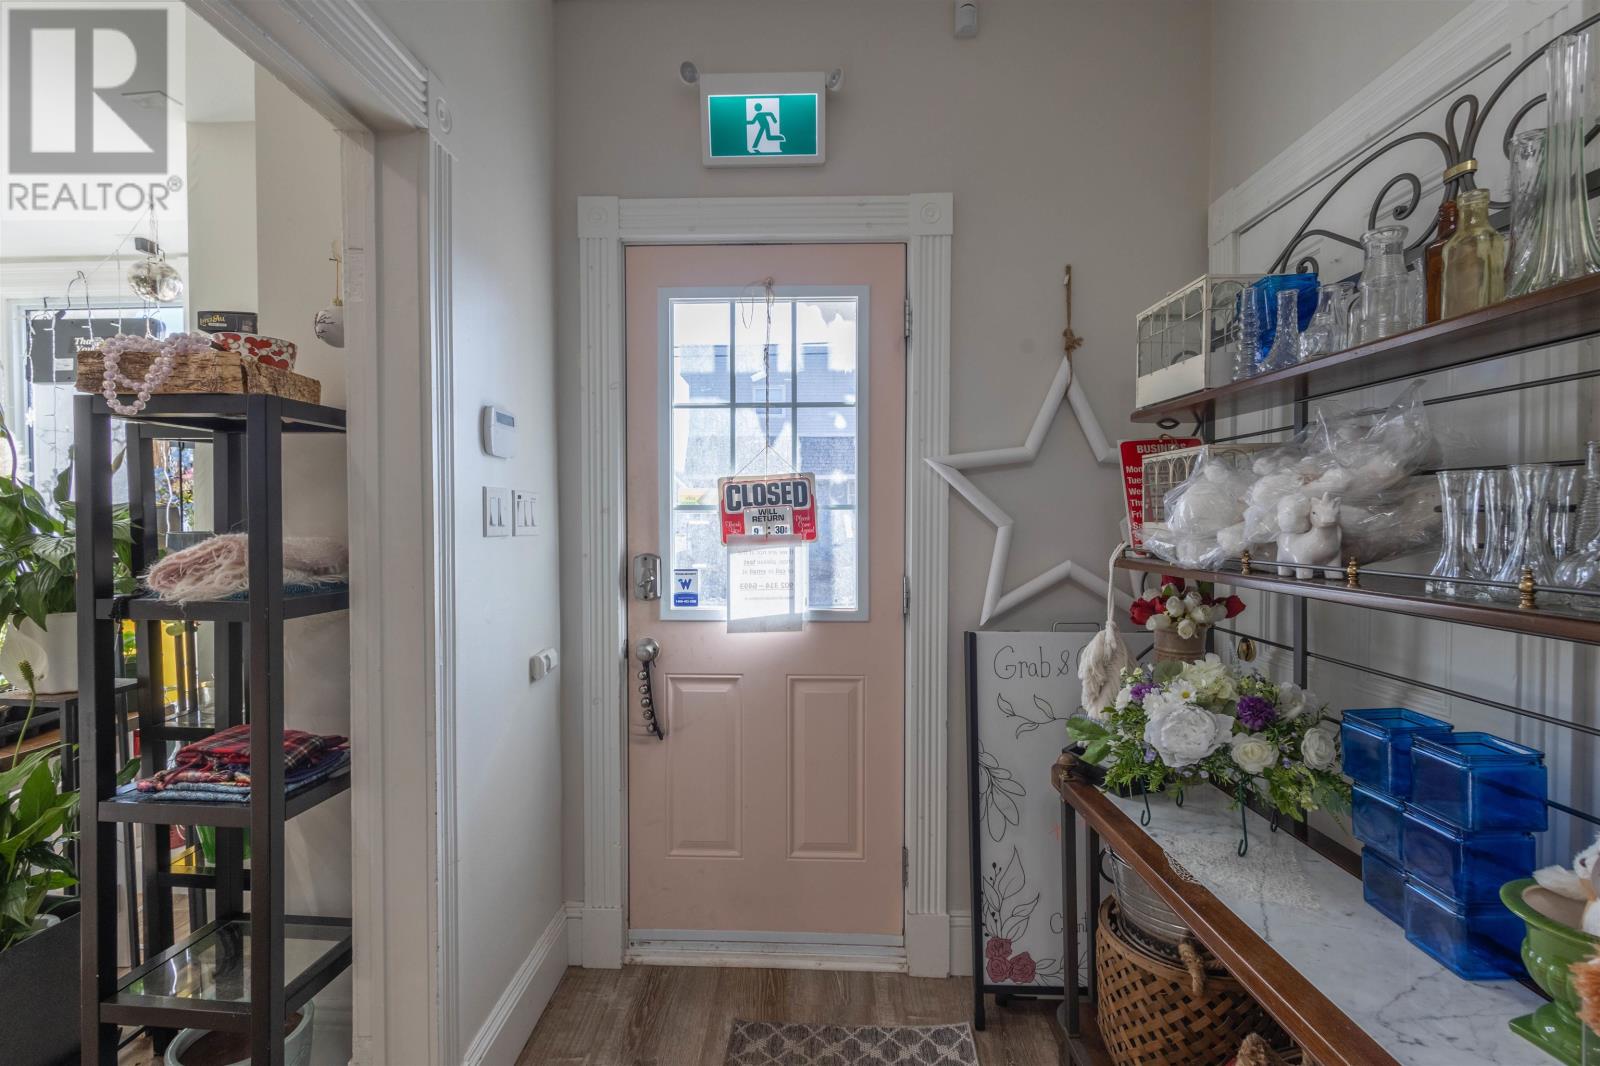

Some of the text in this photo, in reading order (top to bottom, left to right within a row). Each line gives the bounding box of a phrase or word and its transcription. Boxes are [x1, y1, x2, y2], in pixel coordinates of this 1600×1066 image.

[726, 481, 808, 511] CLOSED
[751, 515, 785, 523] RETURN
[758, 508, 778, 516] WILL
[993, 645, 1051, 680] Grab
[1055, 650, 1070, 677] &
